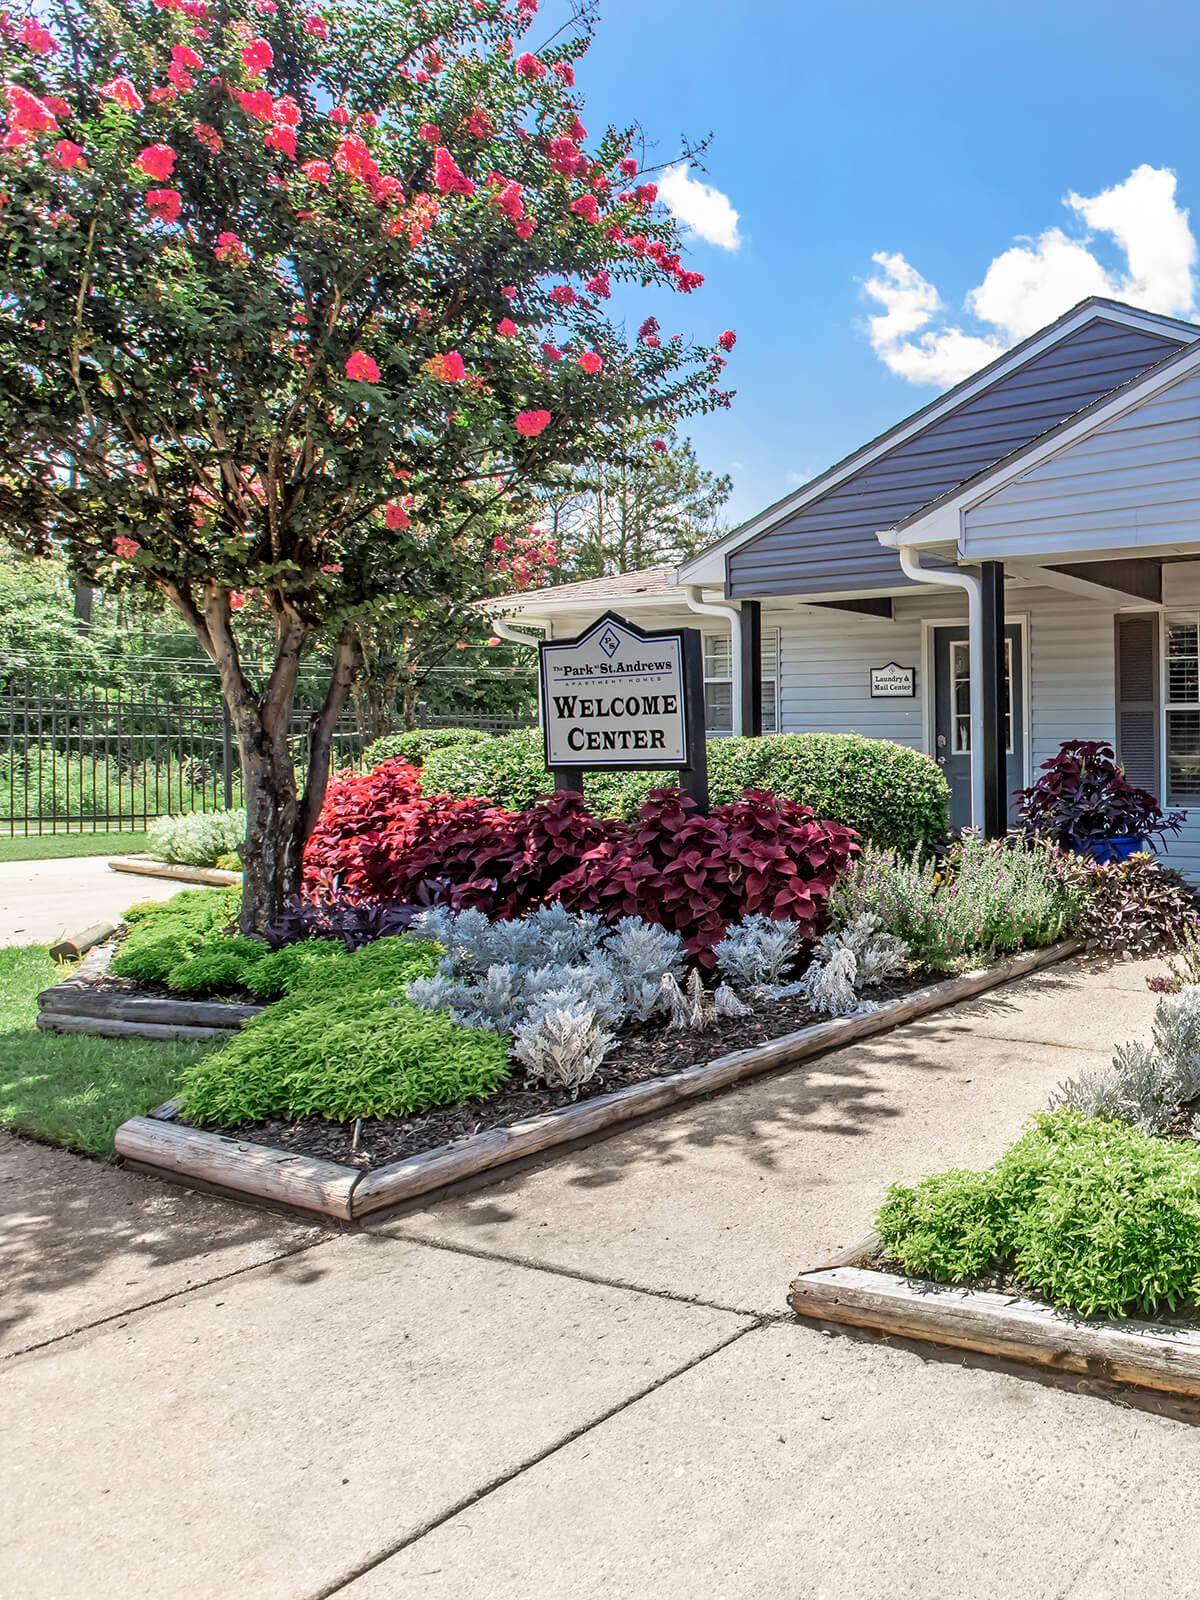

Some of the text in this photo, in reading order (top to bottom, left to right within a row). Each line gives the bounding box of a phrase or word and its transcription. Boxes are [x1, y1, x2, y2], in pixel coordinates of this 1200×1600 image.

[564, 664, 593, 676] Park
[552, 695, 677, 718] WELCOME
[568, 727, 666, 751] CENTER
